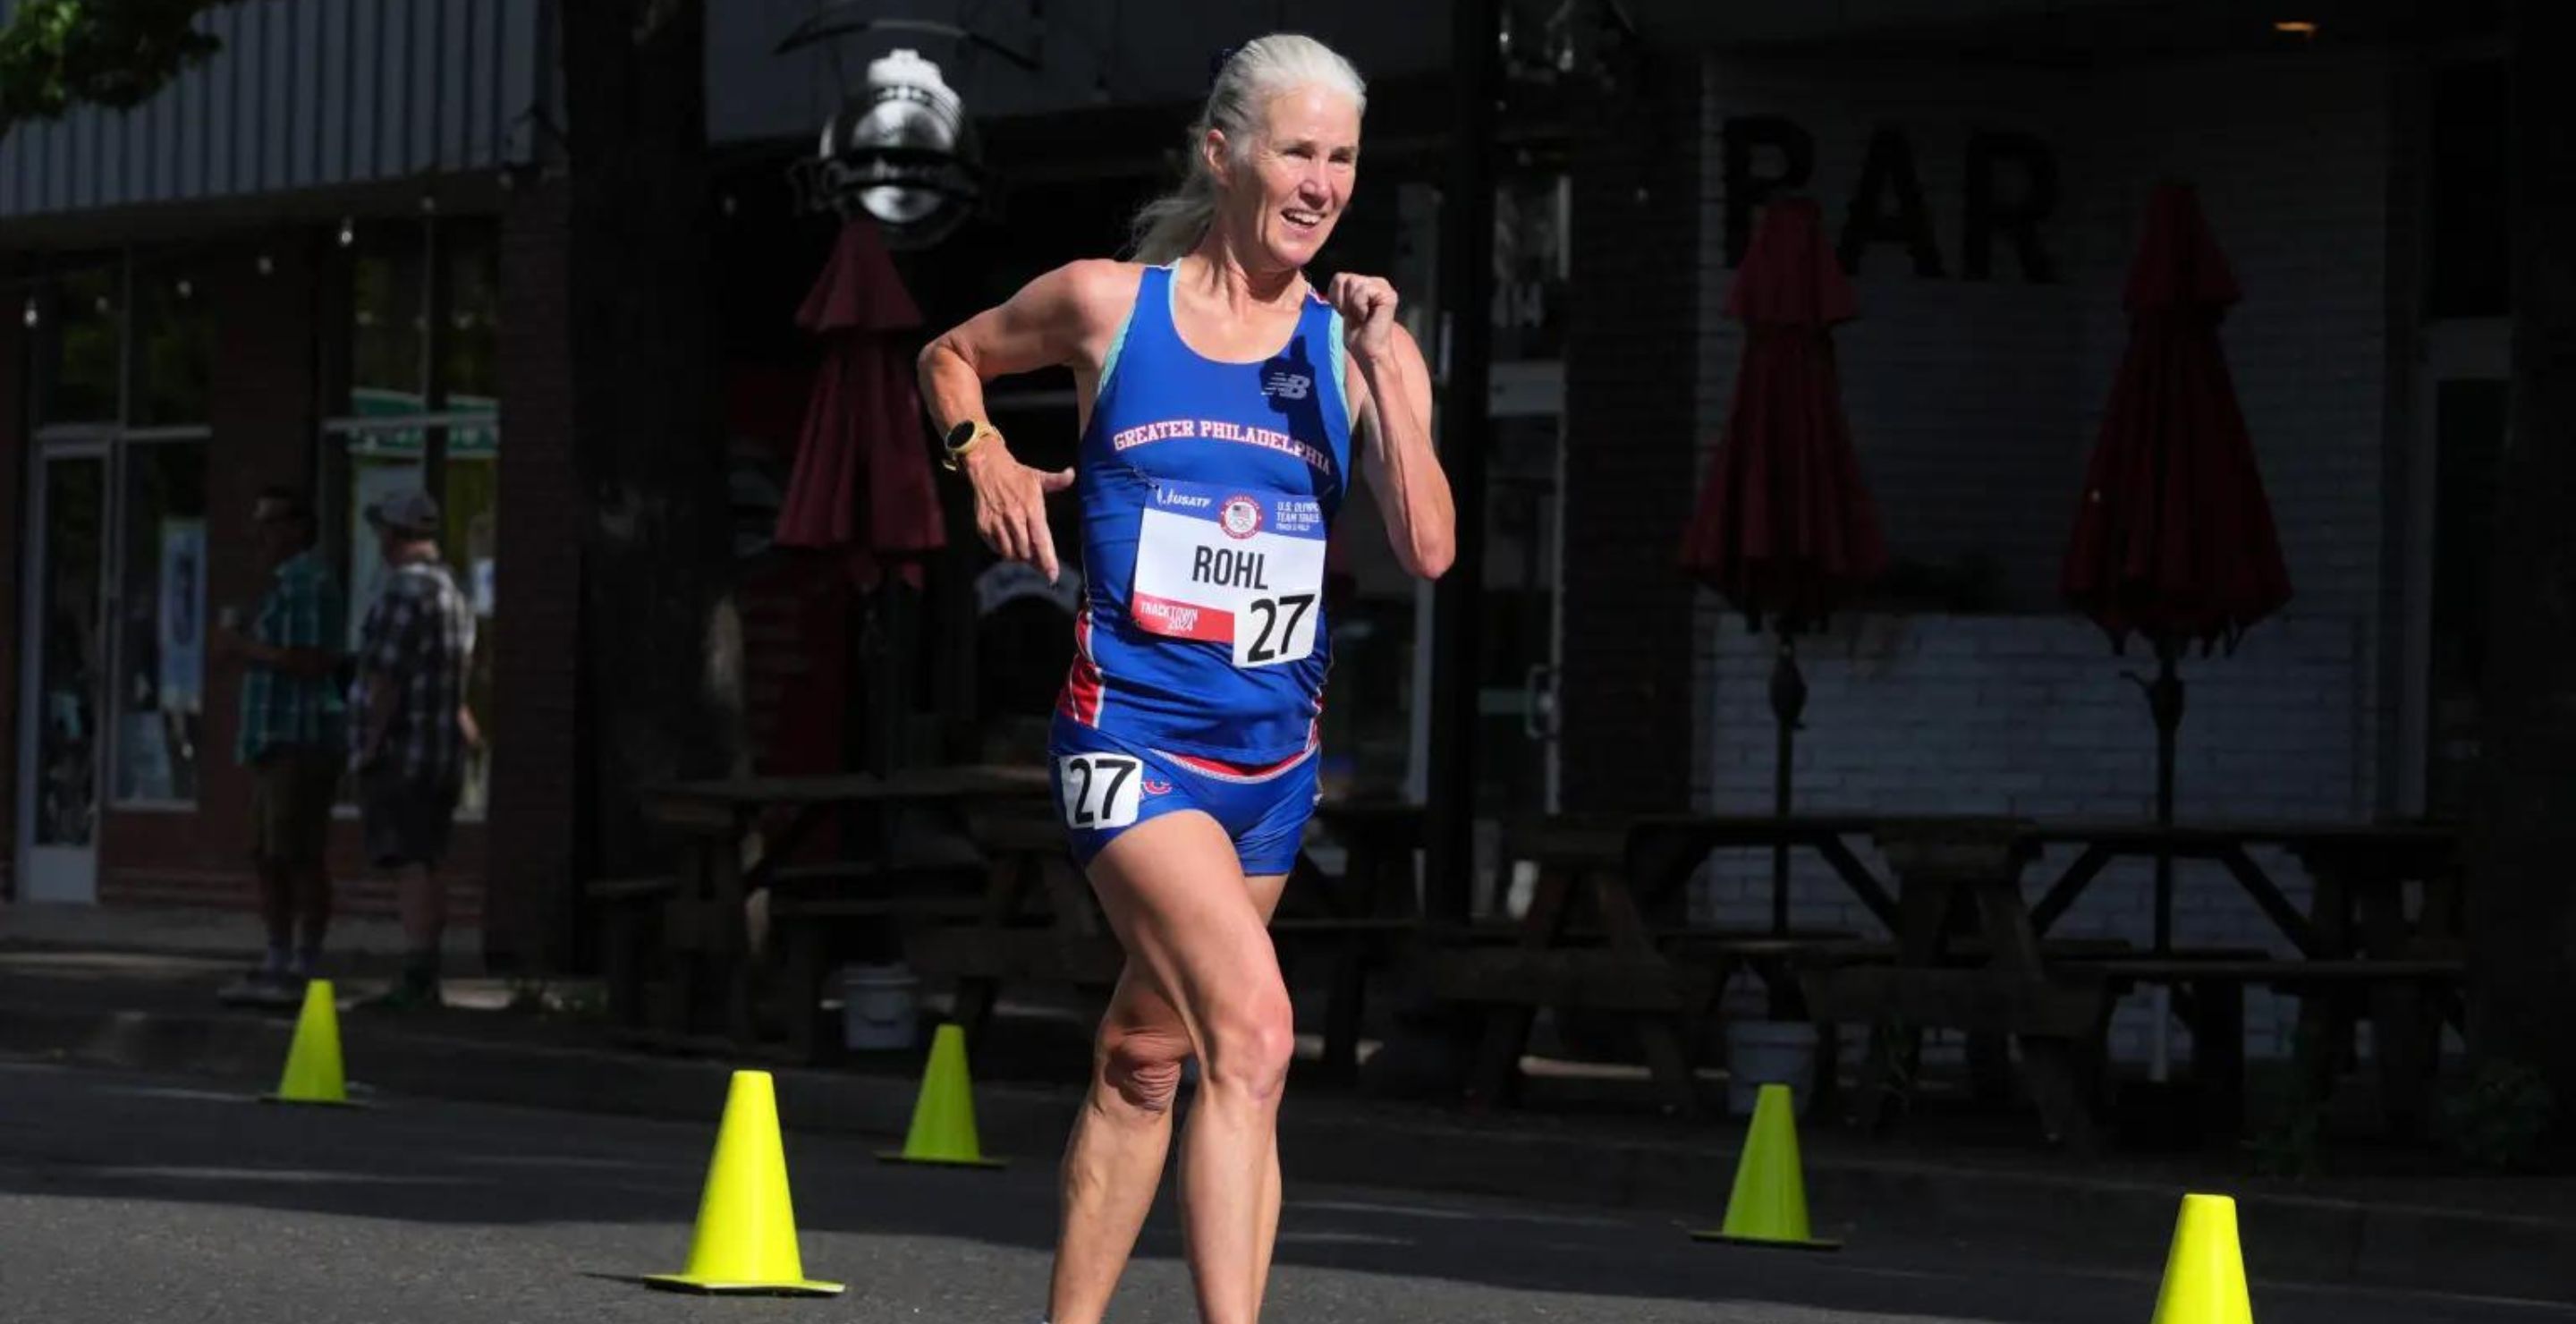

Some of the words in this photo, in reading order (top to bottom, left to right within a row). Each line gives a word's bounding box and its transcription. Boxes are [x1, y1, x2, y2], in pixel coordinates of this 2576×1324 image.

[1114, 420, 1195, 451] GREATER
[1199, 420, 1330, 475] PHILADELPHIA
[1191, 544, 1269, 590] ROHL
[1247, 593, 1316, 664] 27
[1070, 758, 1137, 825] 27
